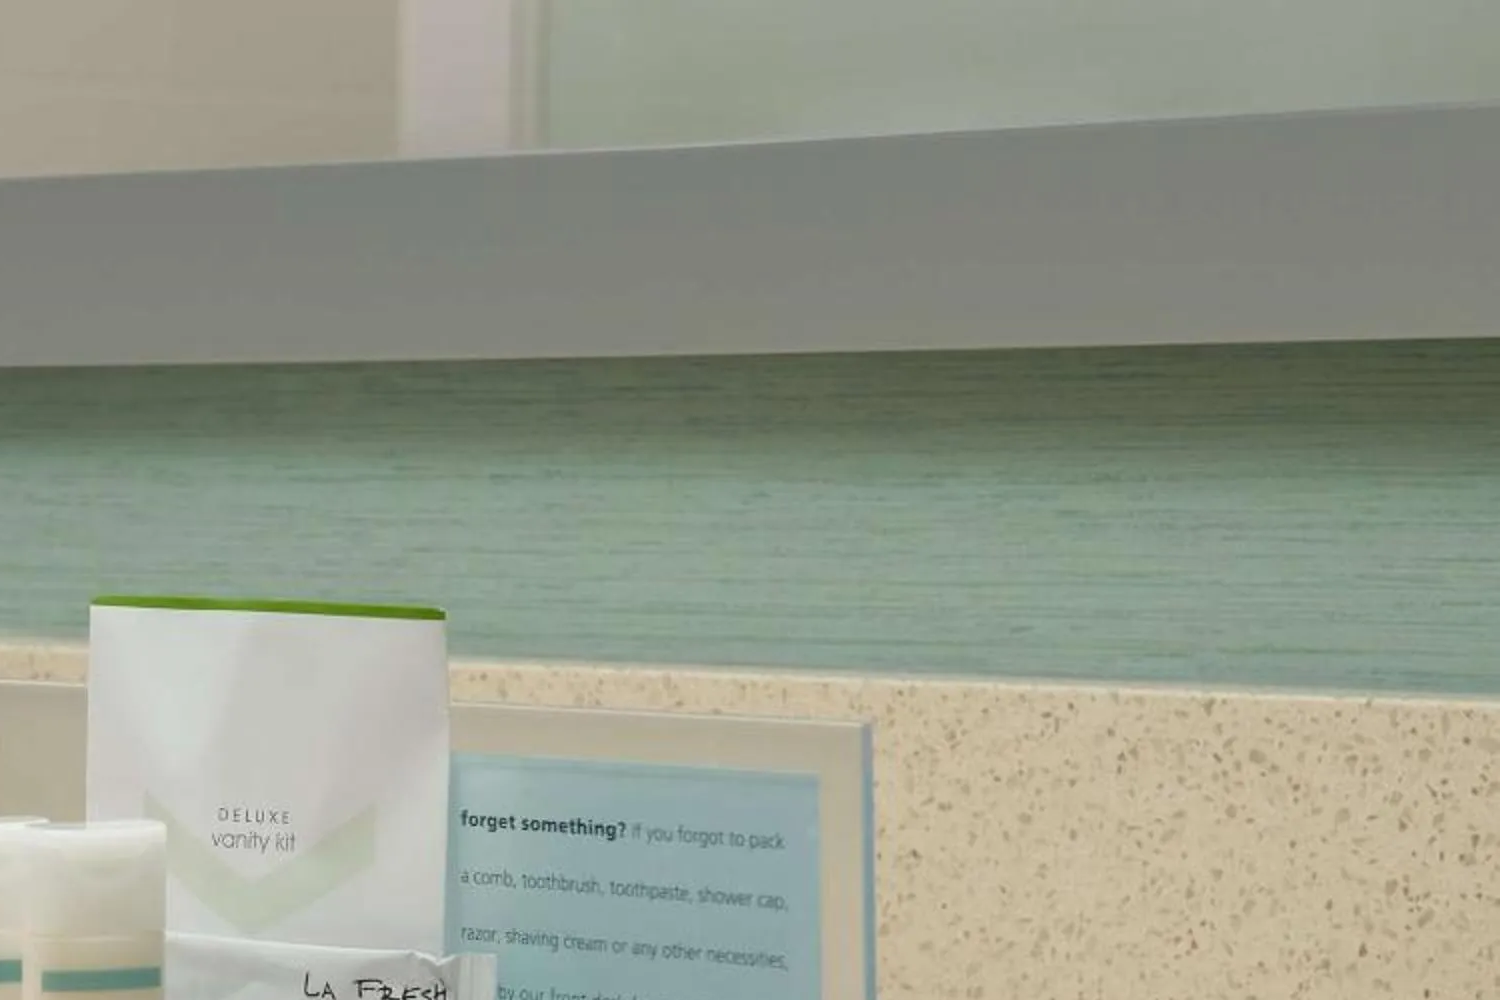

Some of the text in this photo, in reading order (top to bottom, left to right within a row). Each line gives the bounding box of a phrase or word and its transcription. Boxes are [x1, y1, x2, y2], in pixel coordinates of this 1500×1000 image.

[217, 807, 291, 825] DELUXE
[460, 809, 516, 833] forget
[520, 817, 627, 842] something?
[647, 827, 674, 845] you
[677, 824, 724, 849] forgot
[729, 831, 746, 848] to
[748, 832, 786, 851] pack
[211, 831, 296, 854] vanity kit
[460, 870, 470, 883] a
[473, 868, 517, 889] comb,
[521, 872, 605, 896] toothbrush,
[609, 881, 693, 905] toothpaste,
[697, 886, 753, 906] shower
[461, 926, 501, 946] razor,
[504, 927, 560, 954] shaving
[563, 935, 608, 952] cream
[611, 940, 628, 954] or
[631, 941, 657, 961] any
[661, 943, 702, 961] other
[303, 971, 337, 1000] LA
